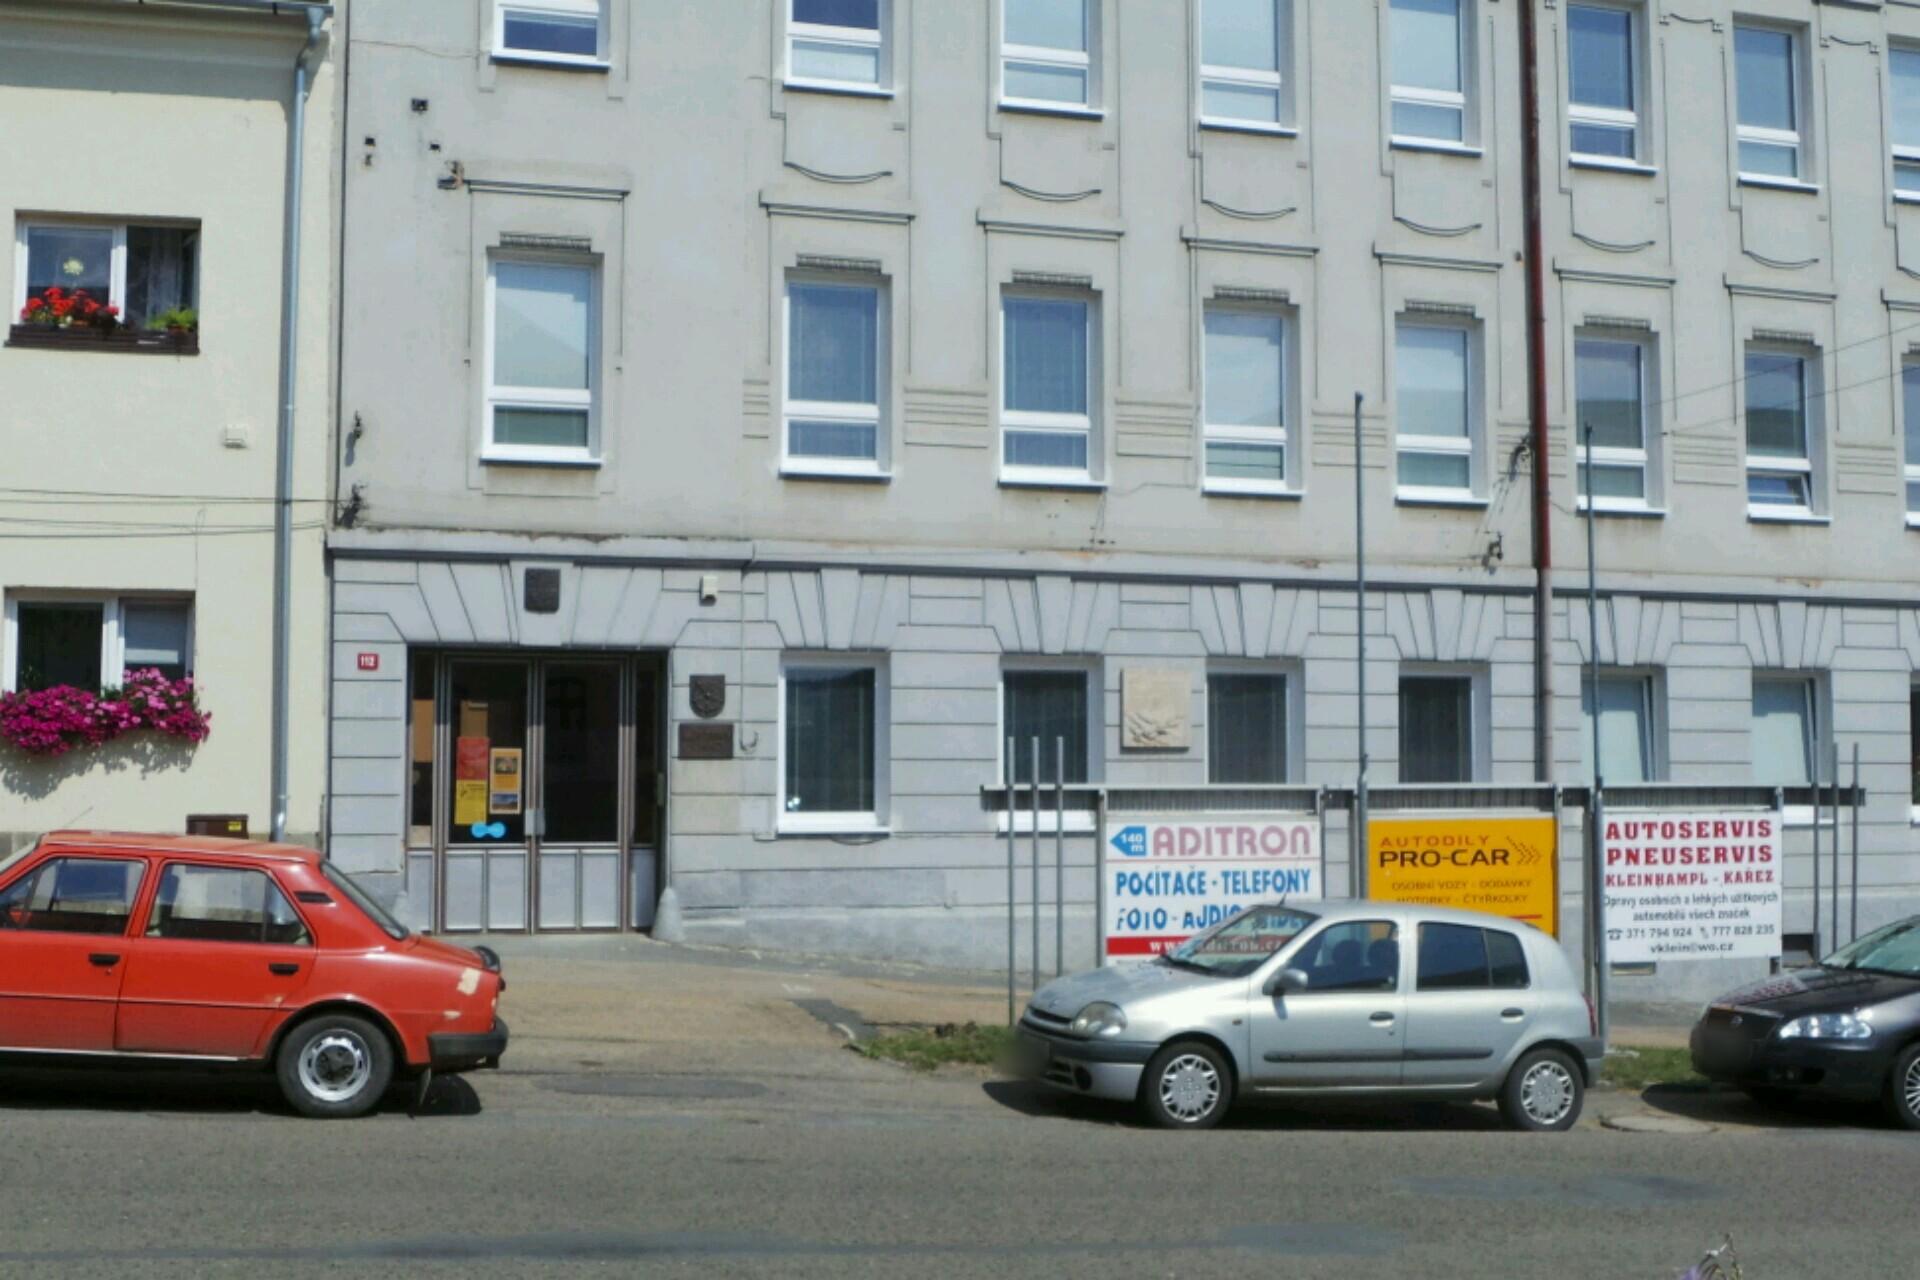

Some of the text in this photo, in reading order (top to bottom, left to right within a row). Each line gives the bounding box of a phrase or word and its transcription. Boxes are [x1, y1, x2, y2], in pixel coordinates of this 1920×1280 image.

[1121, 833, 1143, 844] 140
[1606, 819, 1773, 840] AUTOSERVIS
[1153, 825, 1311, 857] ADITRON
[1379, 848, 1510, 869] PRO-CAR
[1607, 845, 1773, 866] PNEUSERVIS
[1221, 869, 1311, 894] TELEFONY
[1712, 926, 1731, 936] 777
